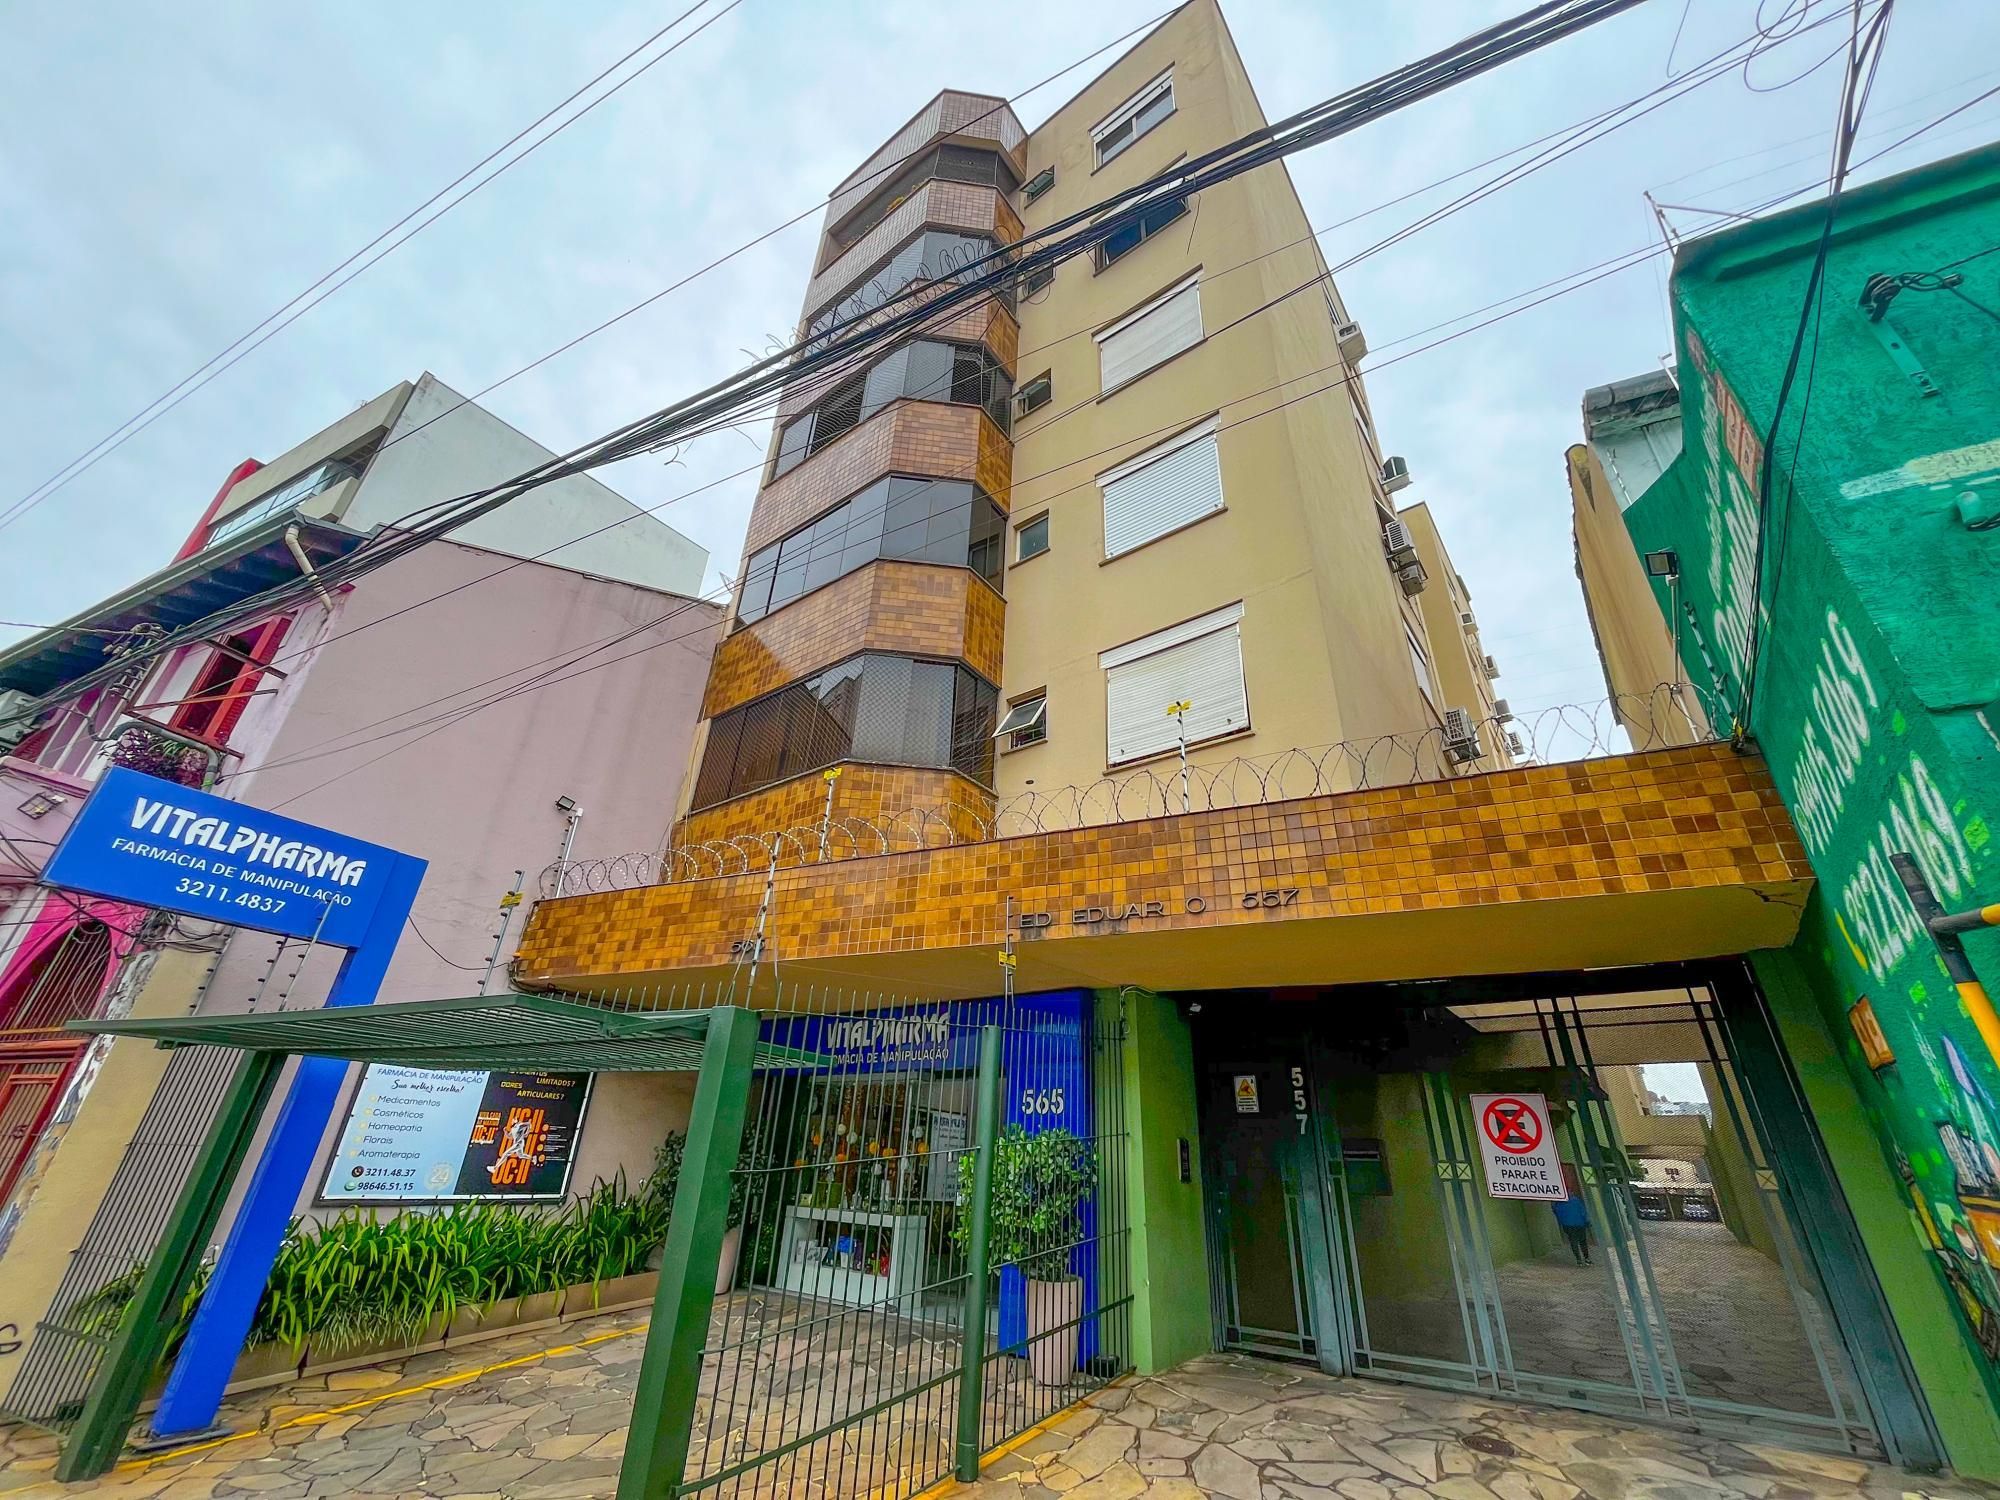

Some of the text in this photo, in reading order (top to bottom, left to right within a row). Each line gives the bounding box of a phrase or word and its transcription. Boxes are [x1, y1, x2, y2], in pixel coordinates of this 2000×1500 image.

[130, 797, 367, 887] VITALPHARMA
[111, 837, 352, 907] FARMÁCIA DE MANIPULAÇÃO
[175, 878, 286, 914] 3211.4837
[1019, 912, 1051, 928] ED
[1242, 888, 1299, 910] 557
[828, 1012, 950, 1049] VITALPHARMA
[867, 1052, 879, 1063] DE
[377, 1068, 417, 1078] FARMÁCIA
[377, 1095, 441, 1107] Medicamentos
[1021, 1088, 1064, 1115] 565
[372, 1108, 424, 1119] Cosméticos
[367, 1121, 423, 1132] Homeopatia
[362, 1135, 393, 1144] Florais
[357, 1149, 421, 1160] Aromaterapia
[1494, 1156, 1546, 1167] PROIBIDO
[364, 1167, 416, 1177] 3211.48.37
[1501, 1169, 1549, 1181] PARAR E
[357, 1182, 414, 1191] 98646.51.15
[1492, 1182, 1562, 1195] ESTACIONAR
